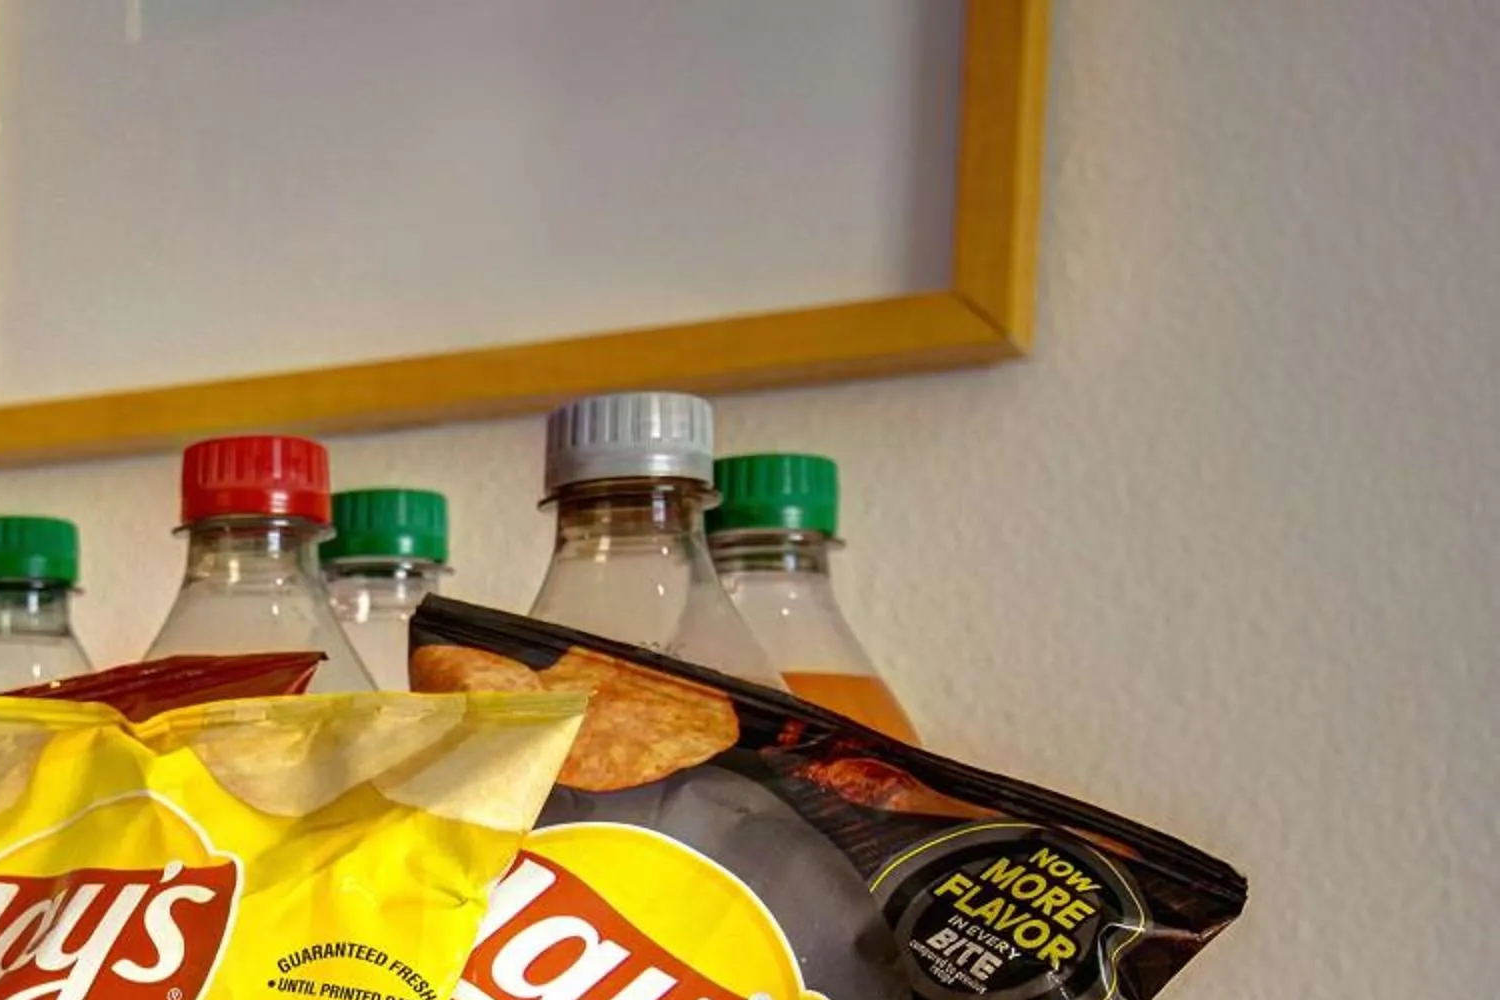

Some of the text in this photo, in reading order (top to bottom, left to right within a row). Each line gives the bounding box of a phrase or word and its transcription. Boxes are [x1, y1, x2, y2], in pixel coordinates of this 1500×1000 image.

[981, 857, 1096, 930] MORE
[1028, 848, 1101, 894] NOW
[933, 873, 1077, 972] FLAVOR
[948, 914, 1021, 960] IN EVERY
[277, 942, 389, 973] GUARANTEED
[926, 927, 1003, 980] BITE
[277, 978, 316, 995] UNTIL
